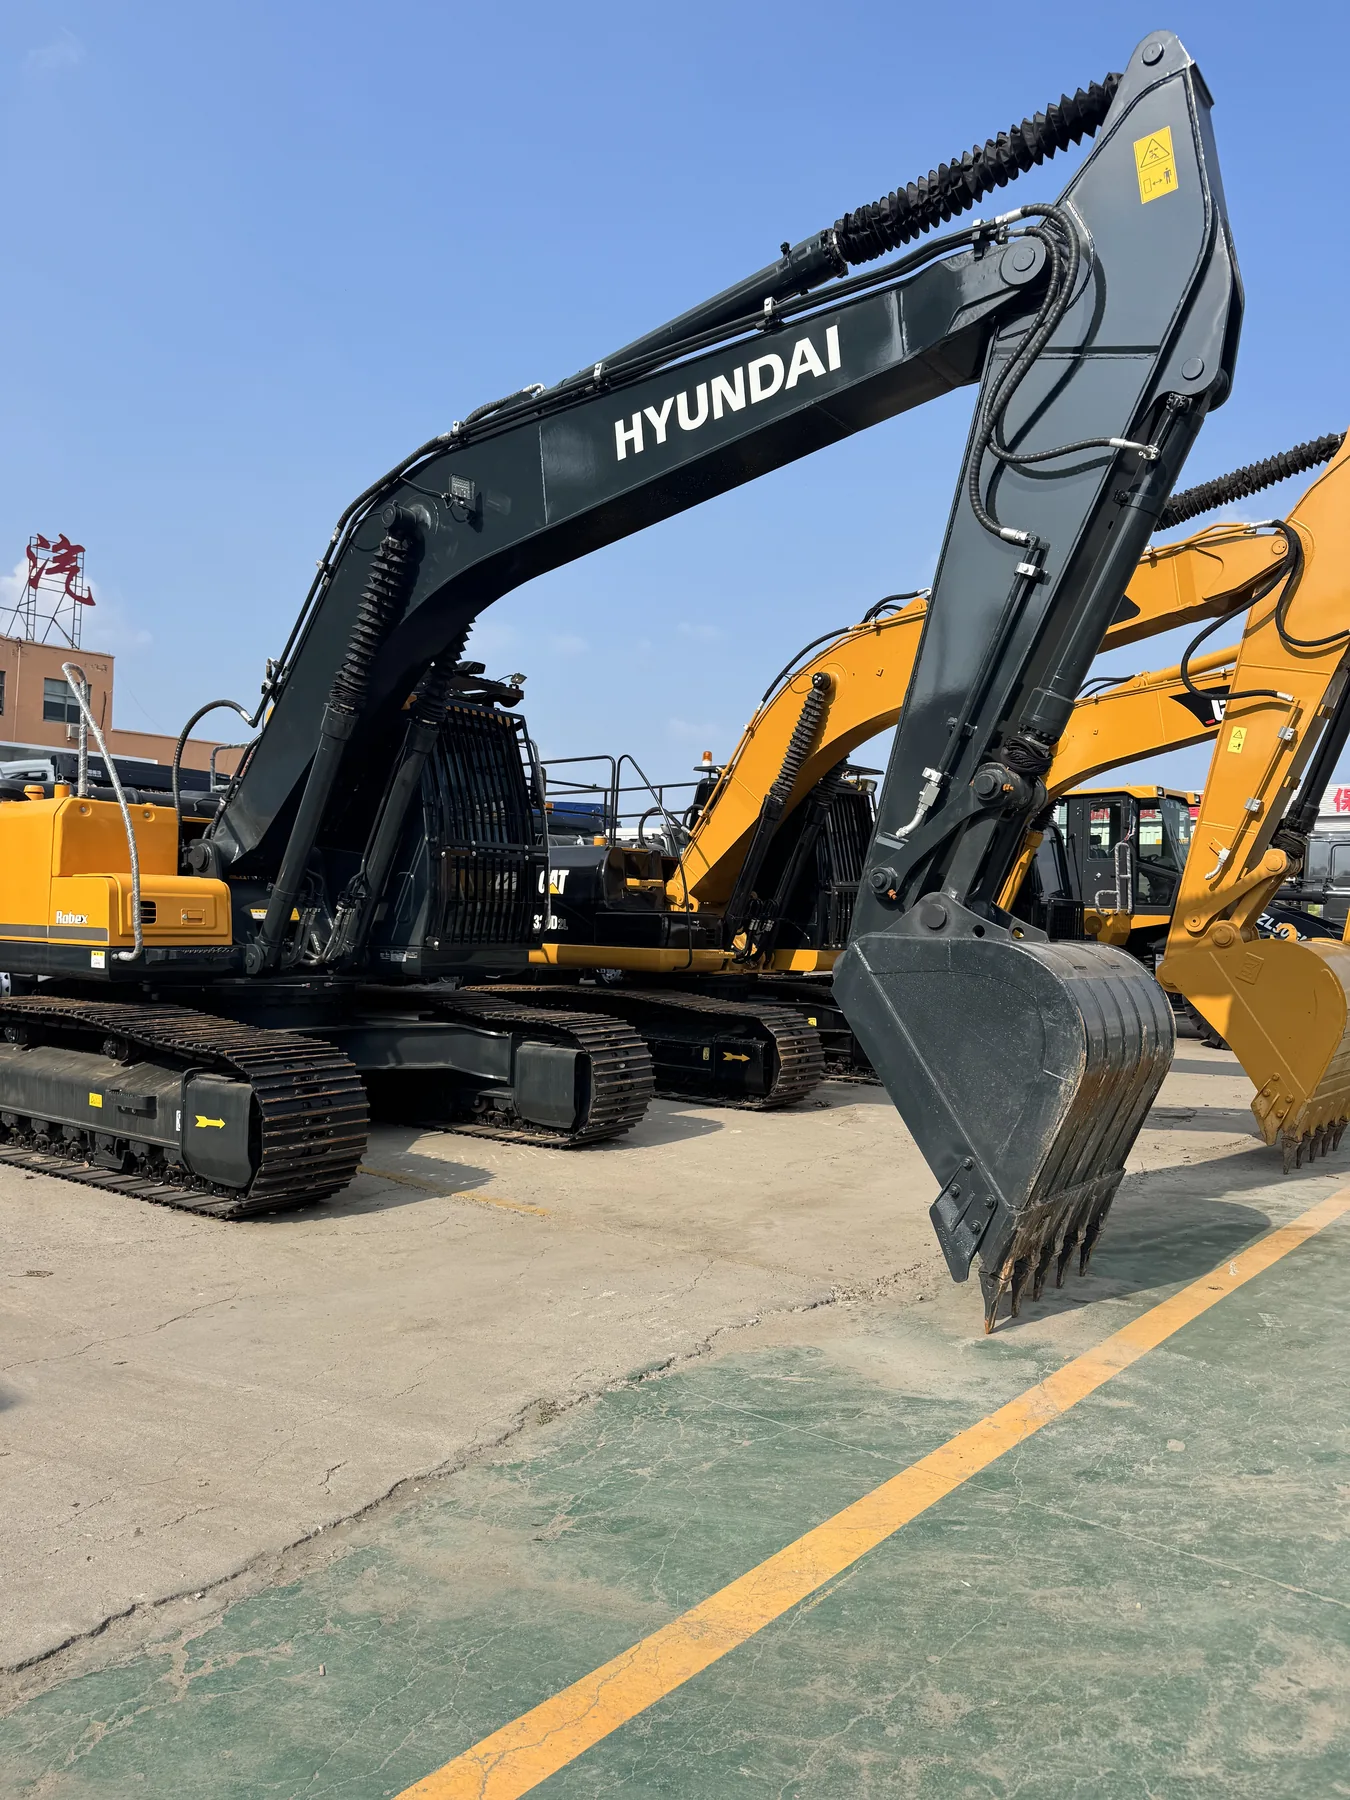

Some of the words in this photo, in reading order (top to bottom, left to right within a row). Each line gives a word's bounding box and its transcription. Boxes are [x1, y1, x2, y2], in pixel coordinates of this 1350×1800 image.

[614, 324, 842, 462] HYUNDAI
[26, 533, 96, 606] 汽
[538, 869, 570, 895] CAT
